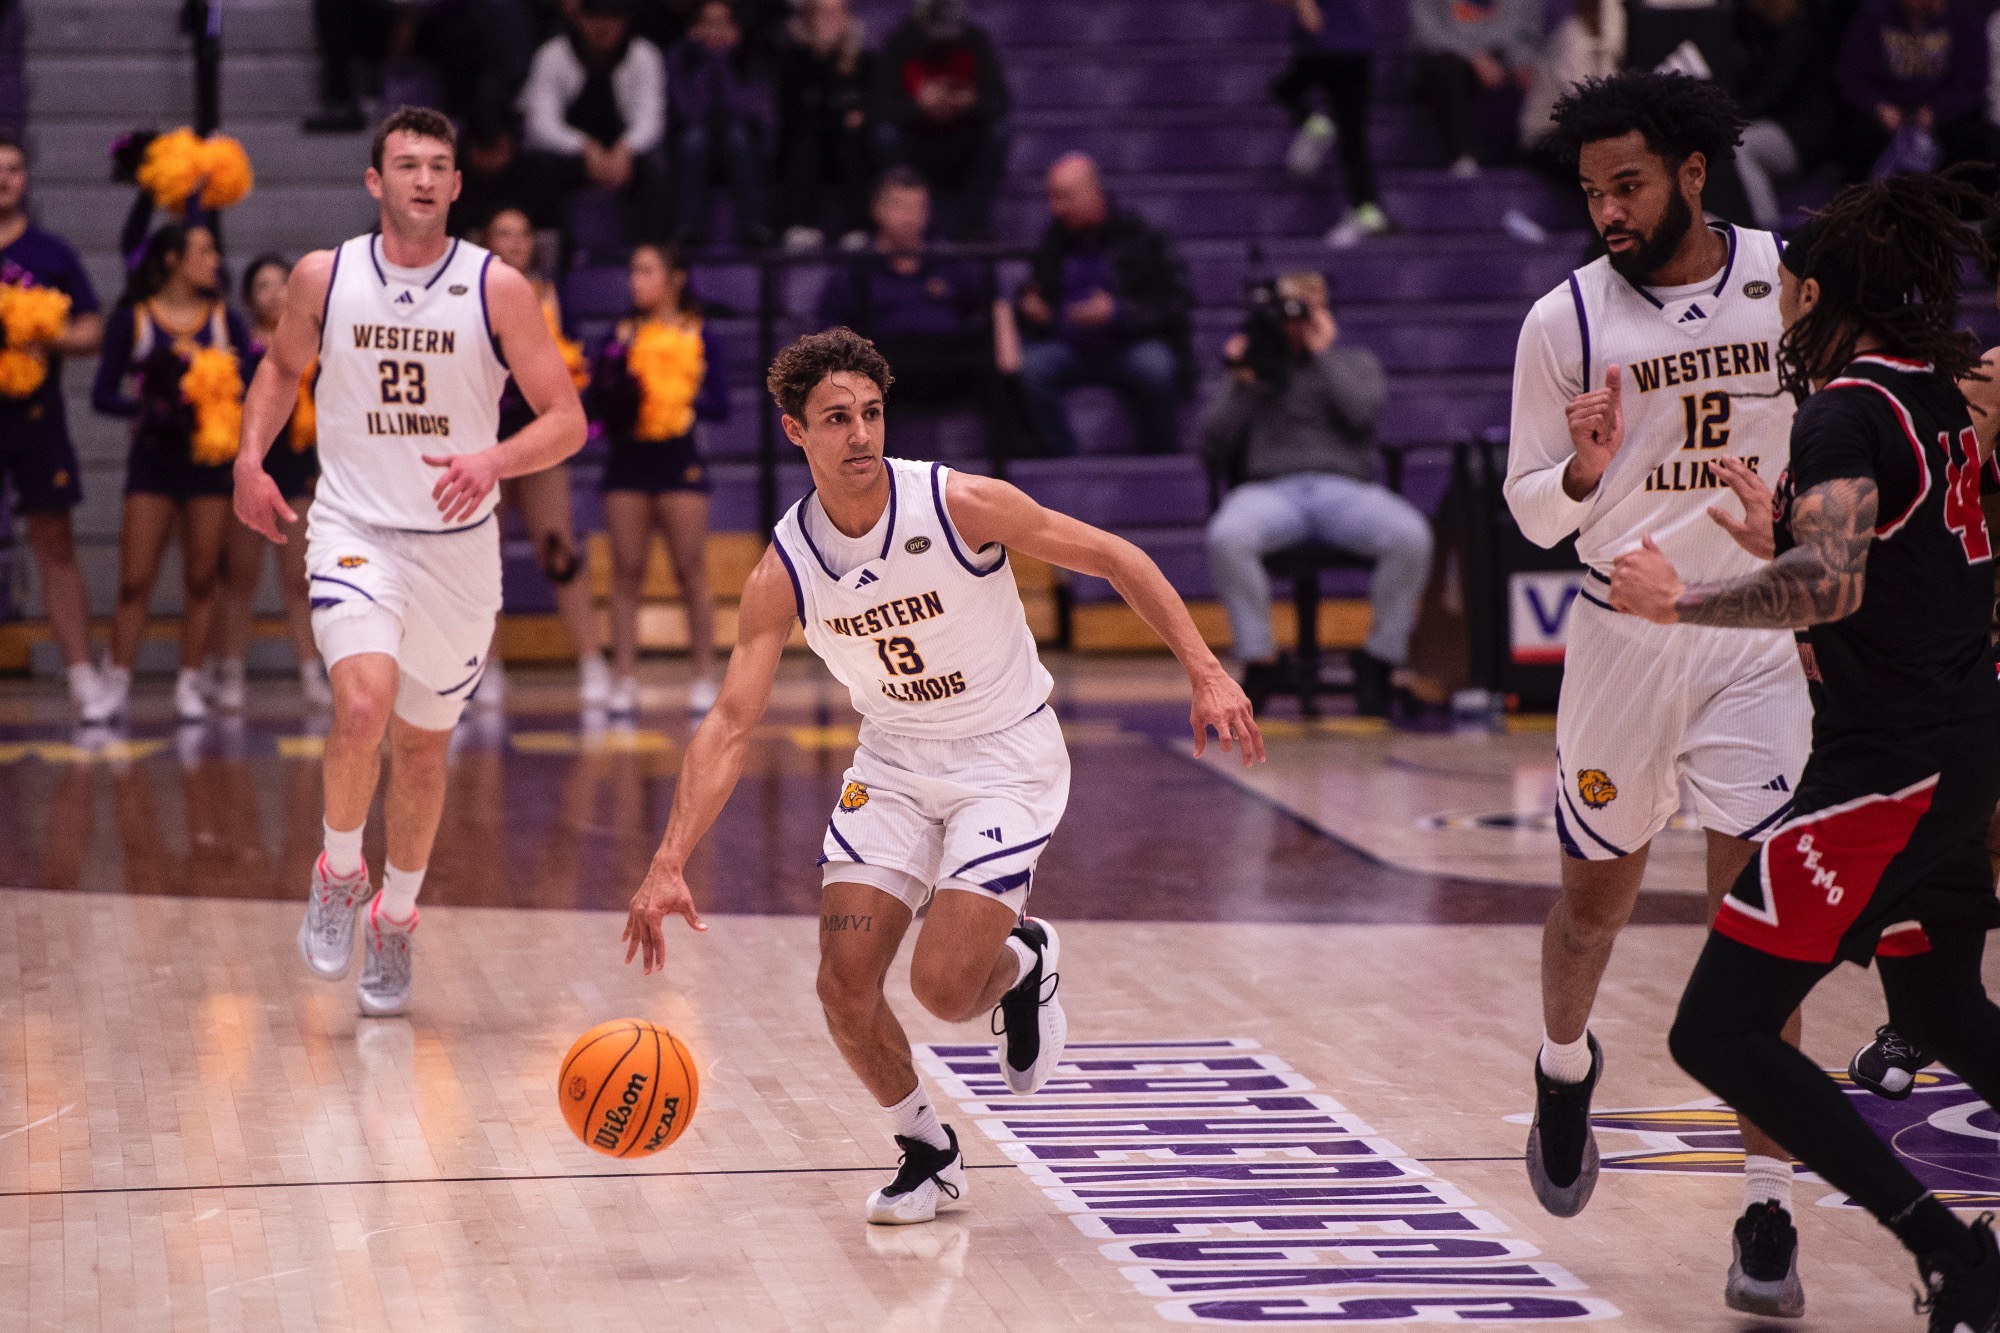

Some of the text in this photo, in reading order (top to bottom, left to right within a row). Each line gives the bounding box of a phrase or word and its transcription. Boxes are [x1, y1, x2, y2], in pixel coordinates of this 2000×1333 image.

[353, 323, 455, 354] WESTERN
[378, 358, 427, 406] 23
[1629, 341, 1770, 394] WESTERN
[366, 411, 450, 437] ILLINOIS
[1681, 389, 1731, 450] 12
[824, 591, 944, 636] WESTERN
[872, 636, 927, 677] 13
[1796, 833, 1845, 906] SEMO
[821, 914, 873, 931] MMVI
[593, 1072, 648, 1150] Wilson
[643, 1097, 680, 1151] NCAA
[928, 1040, 1591, 1322] LEATHERNECKS
